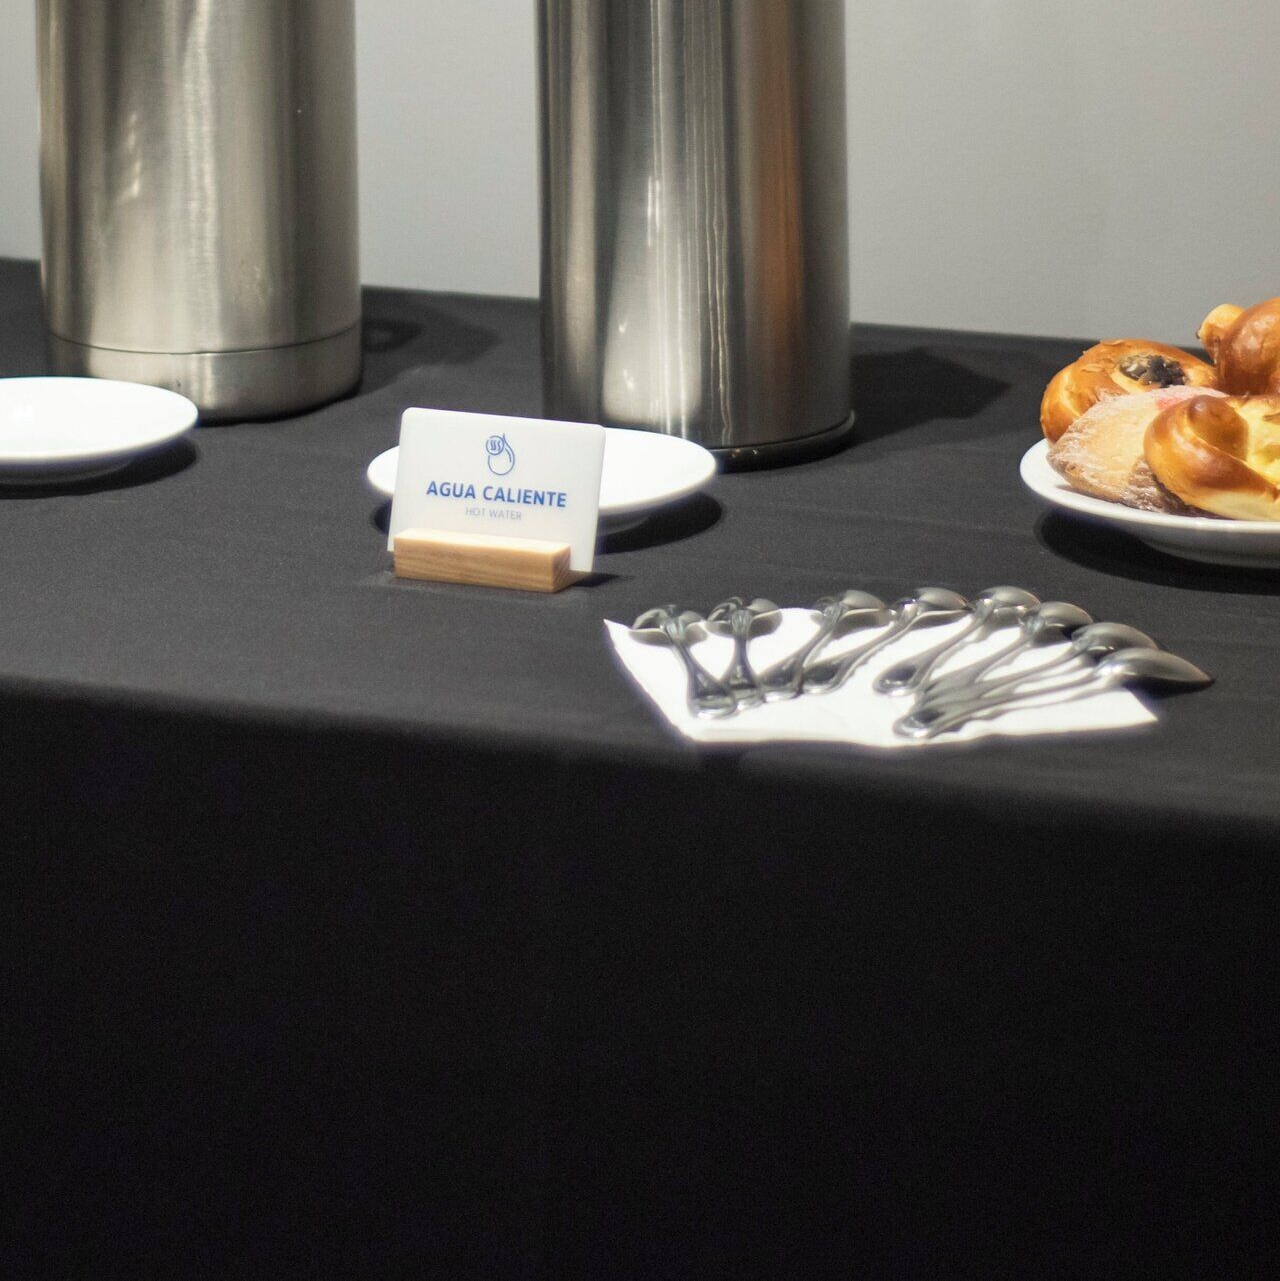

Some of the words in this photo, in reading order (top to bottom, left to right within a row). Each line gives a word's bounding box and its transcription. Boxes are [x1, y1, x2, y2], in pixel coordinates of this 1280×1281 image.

[426, 480, 477, 500] AGUA
[483, 485, 567, 507] CALIENTE
[465, 507, 487, 517] HOT
[489, 509, 522, 520] WATER
